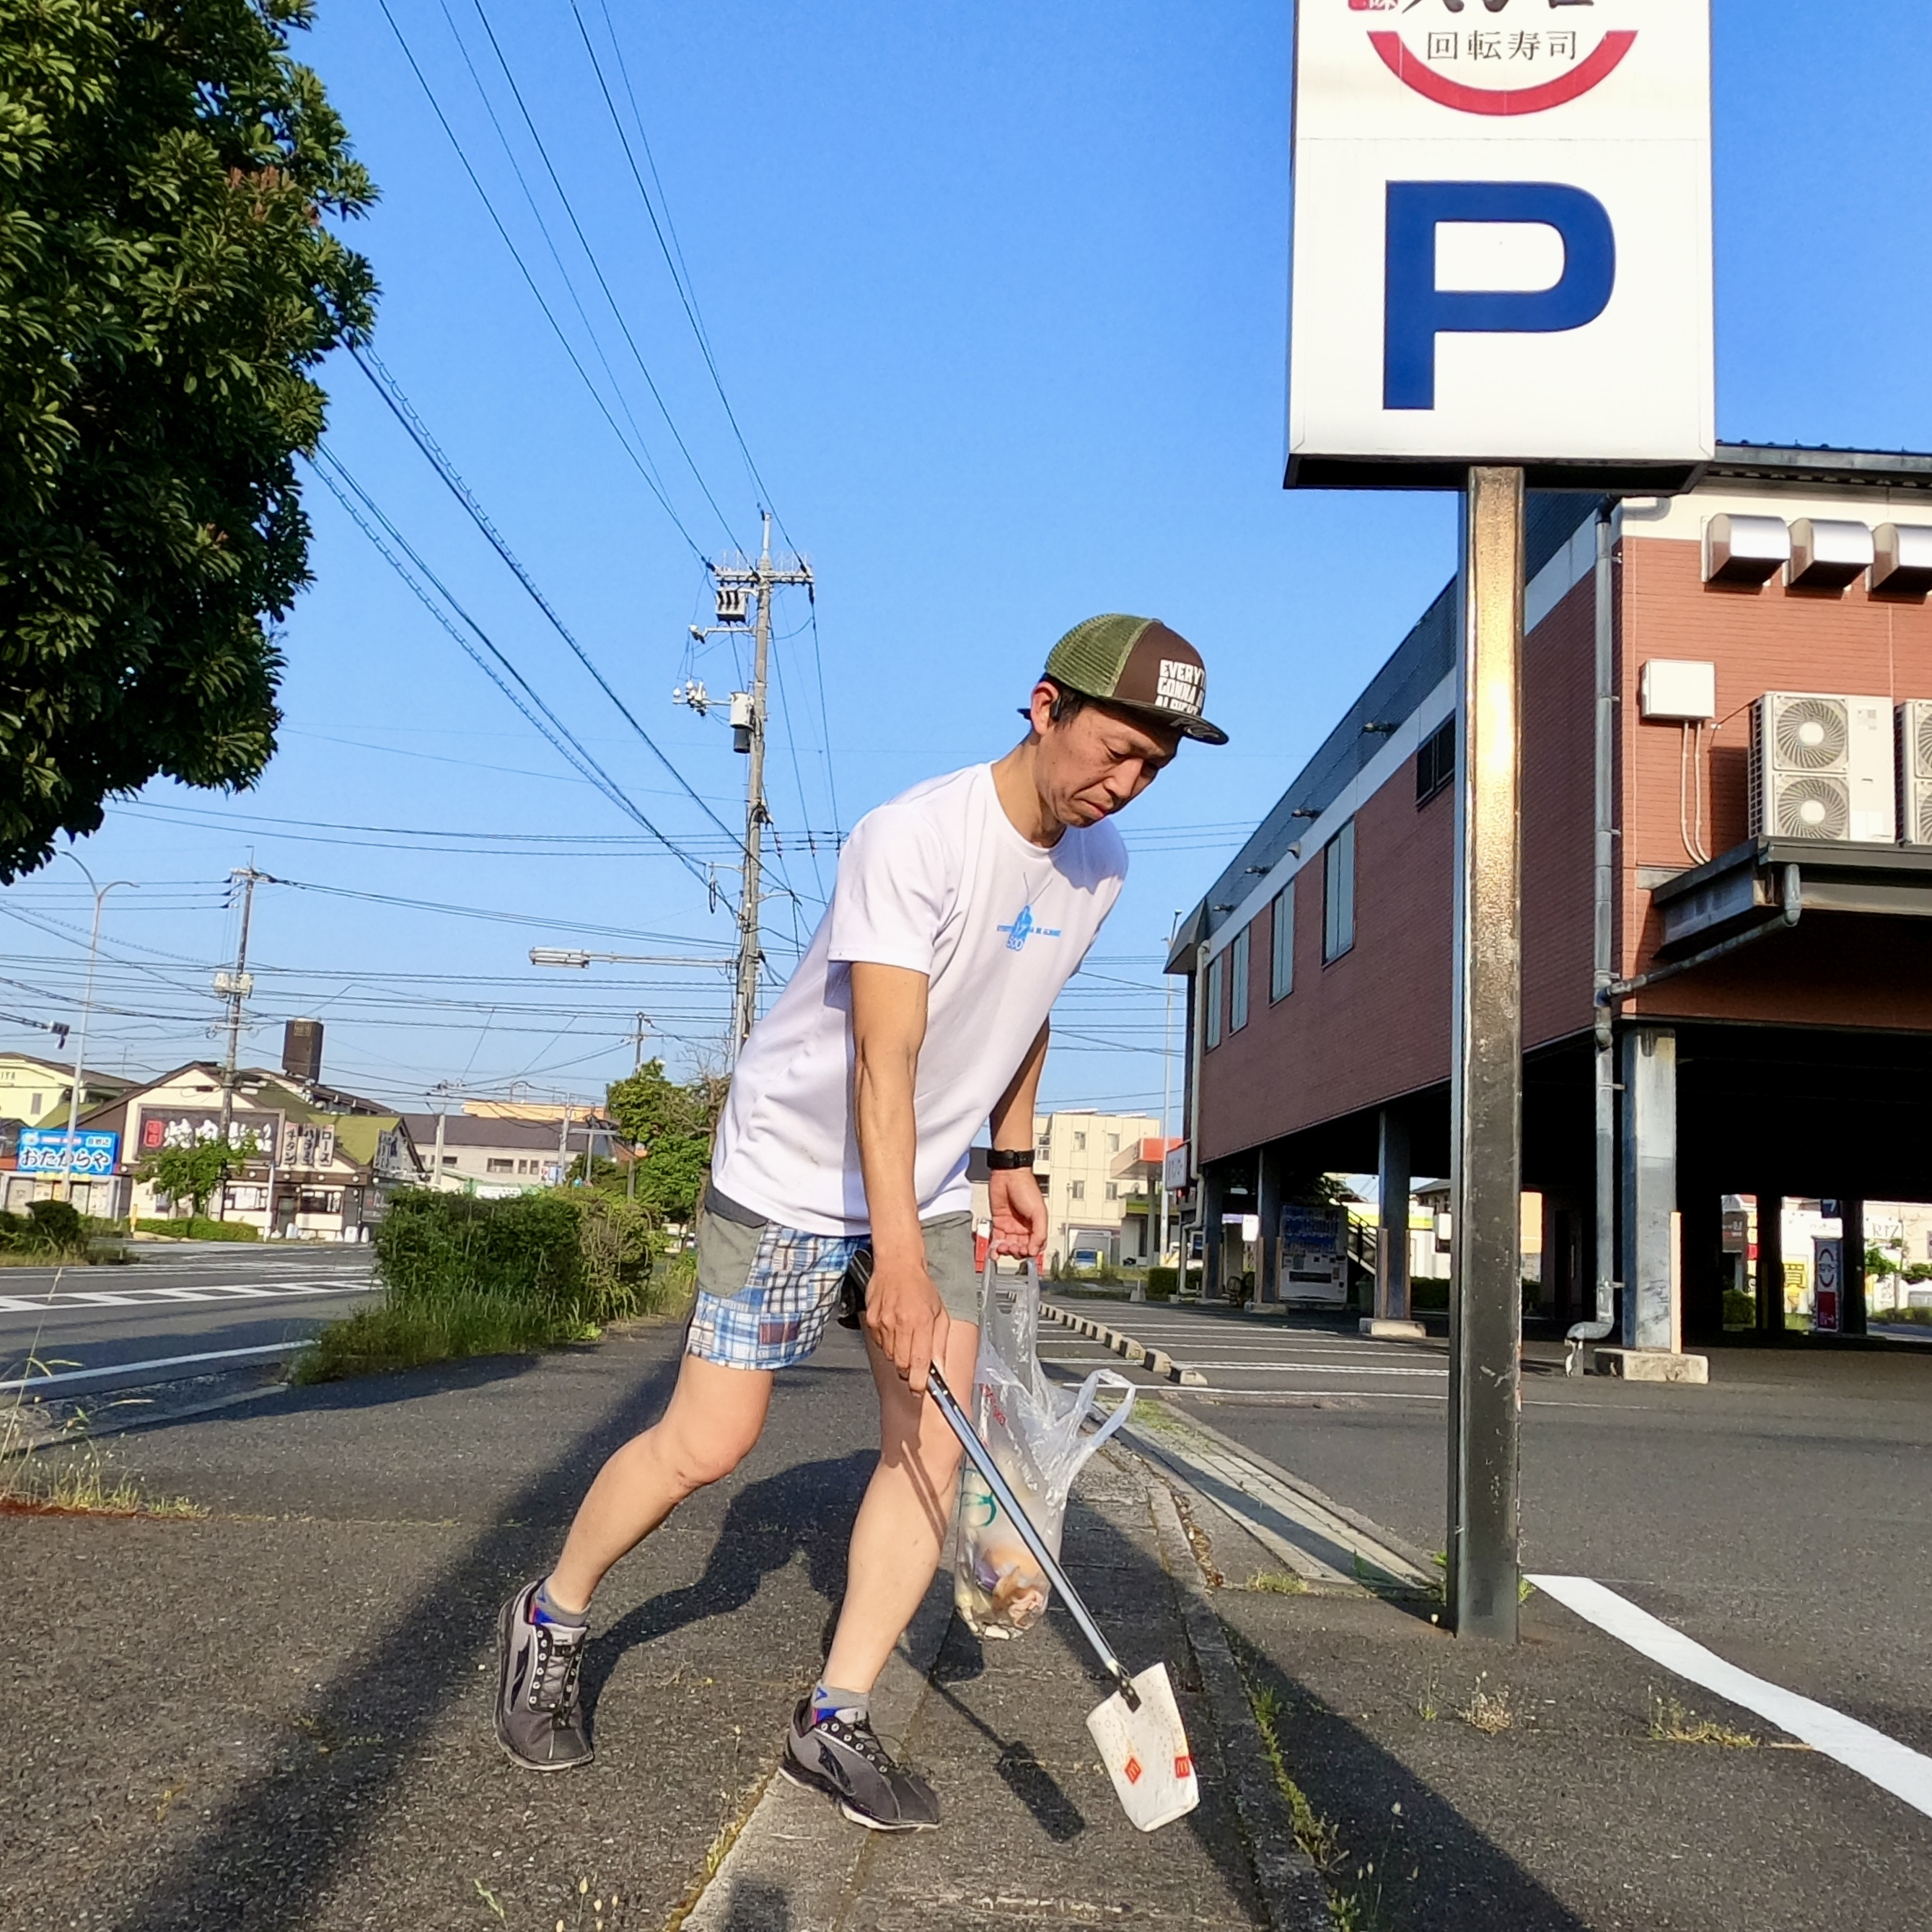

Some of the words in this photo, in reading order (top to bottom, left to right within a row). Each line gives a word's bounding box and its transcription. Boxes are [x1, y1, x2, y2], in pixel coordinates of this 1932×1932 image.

[1427, 29, 1577, 61] 回転寿司
[1382, 180, 1616, 410] P
[320, 1130, 332, 1163] ロース
